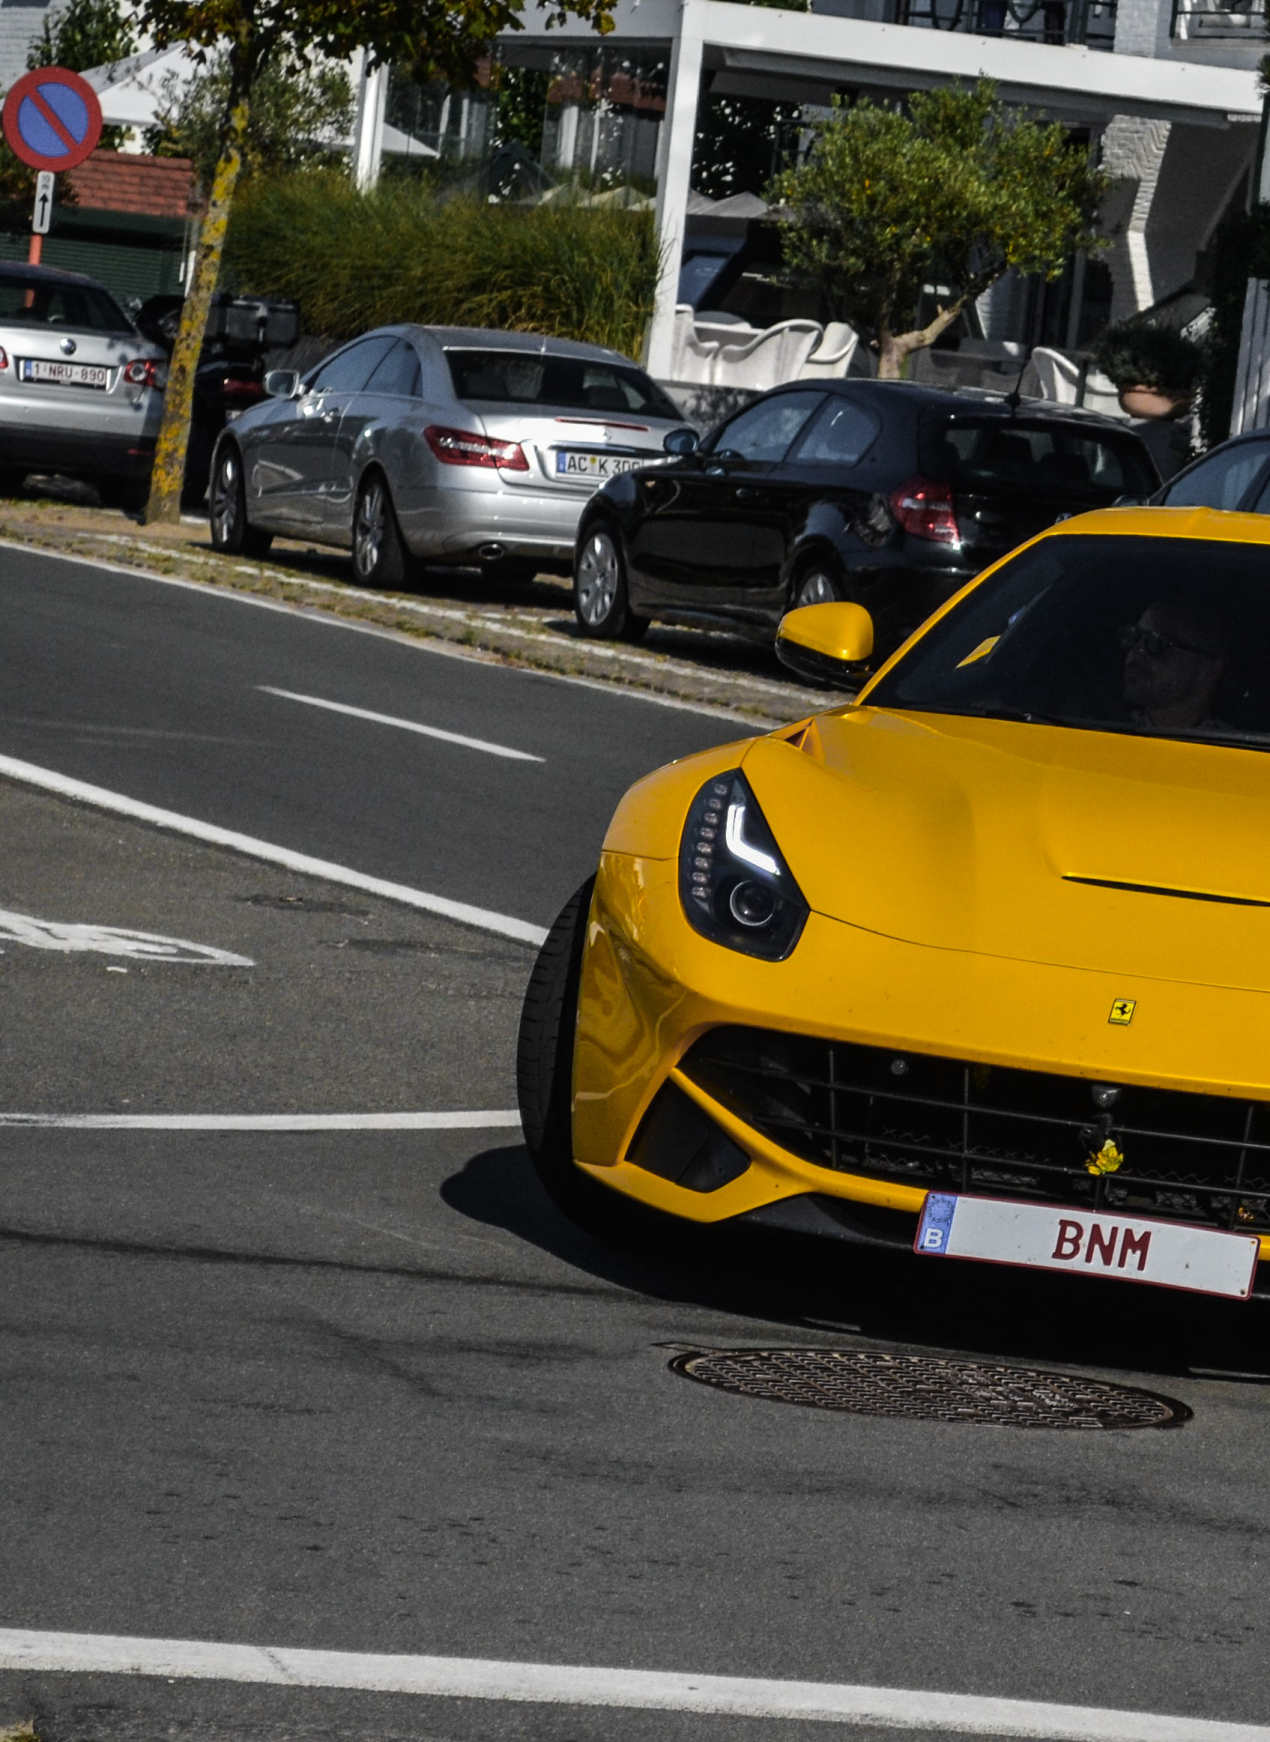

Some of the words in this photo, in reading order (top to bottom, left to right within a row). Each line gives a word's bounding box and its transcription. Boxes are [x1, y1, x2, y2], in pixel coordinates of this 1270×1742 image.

[567, 455, 587, 472] AC
[598, 457, 608, 475] K
[922, 1227, 944, 1249] B
[1051, 1218, 1152, 1272] BNM
